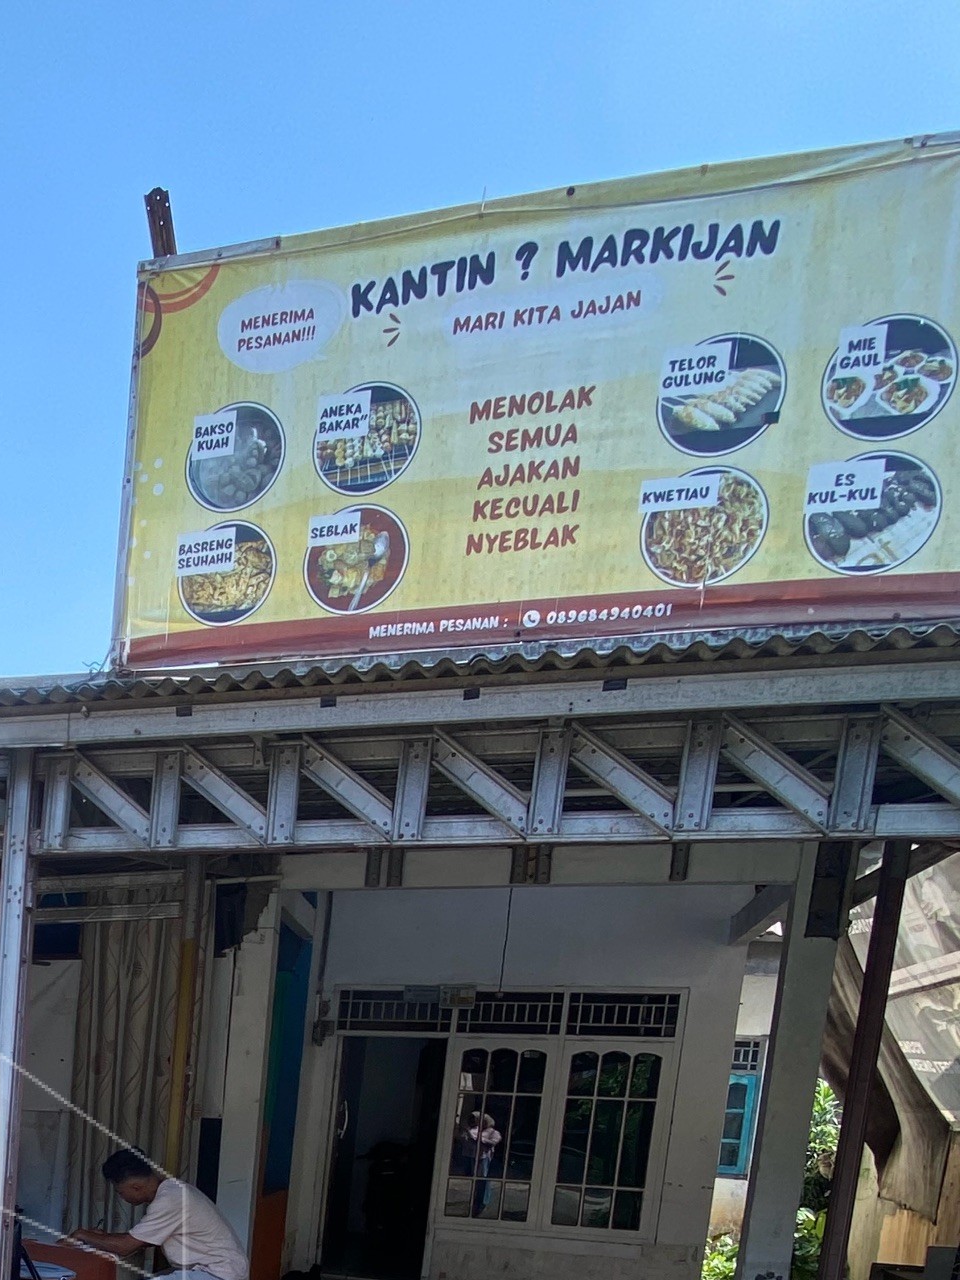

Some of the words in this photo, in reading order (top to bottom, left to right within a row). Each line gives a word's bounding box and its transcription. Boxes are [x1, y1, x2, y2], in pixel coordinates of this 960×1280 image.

[351, 251, 496, 318] KANTIN
[555, 219, 781, 278] MARKIJAN
[241, 307, 315, 333] MENERIMA
[452, 309, 506, 335] MARI
[513, 304, 562, 328] KITA
[570, 289, 641, 320] JAJAN
[238, 326, 316, 352] PESANAN!!!
[847, 336, 877, 354] MIE
[668, 354, 717, 373] TELOR
[839, 351, 882, 371] GAUL
[661, 369, 726, 390] GULUNG
[320, 403, 362, 420] ANEKA
[469, 385, 596, 425] MENOLAK
[194, 421, 234, 439] BAKSO
[487, 423, 579, 454] SEMUA
[197, 437, 229, 452] KUAH
[476, 456, 581, 491] AJAKAN
[834, 473, 856, 487] ES
[642, 485, 710, 505] KWETIAU
[807, 487, 878, 506] KUL-KUL
[472, 489, 580, 522] KECUALI
[310, 523, 359, 539] SEBLAK
[465, 524, 580, 556] NYEBLAK
[178, 538, 233, 556] BASRENG
[178, 552, 233, 569] SEUHAHH
[369, 621, 435, 639] MENERIMA
[439, 616, 500, 633] PESANAN
